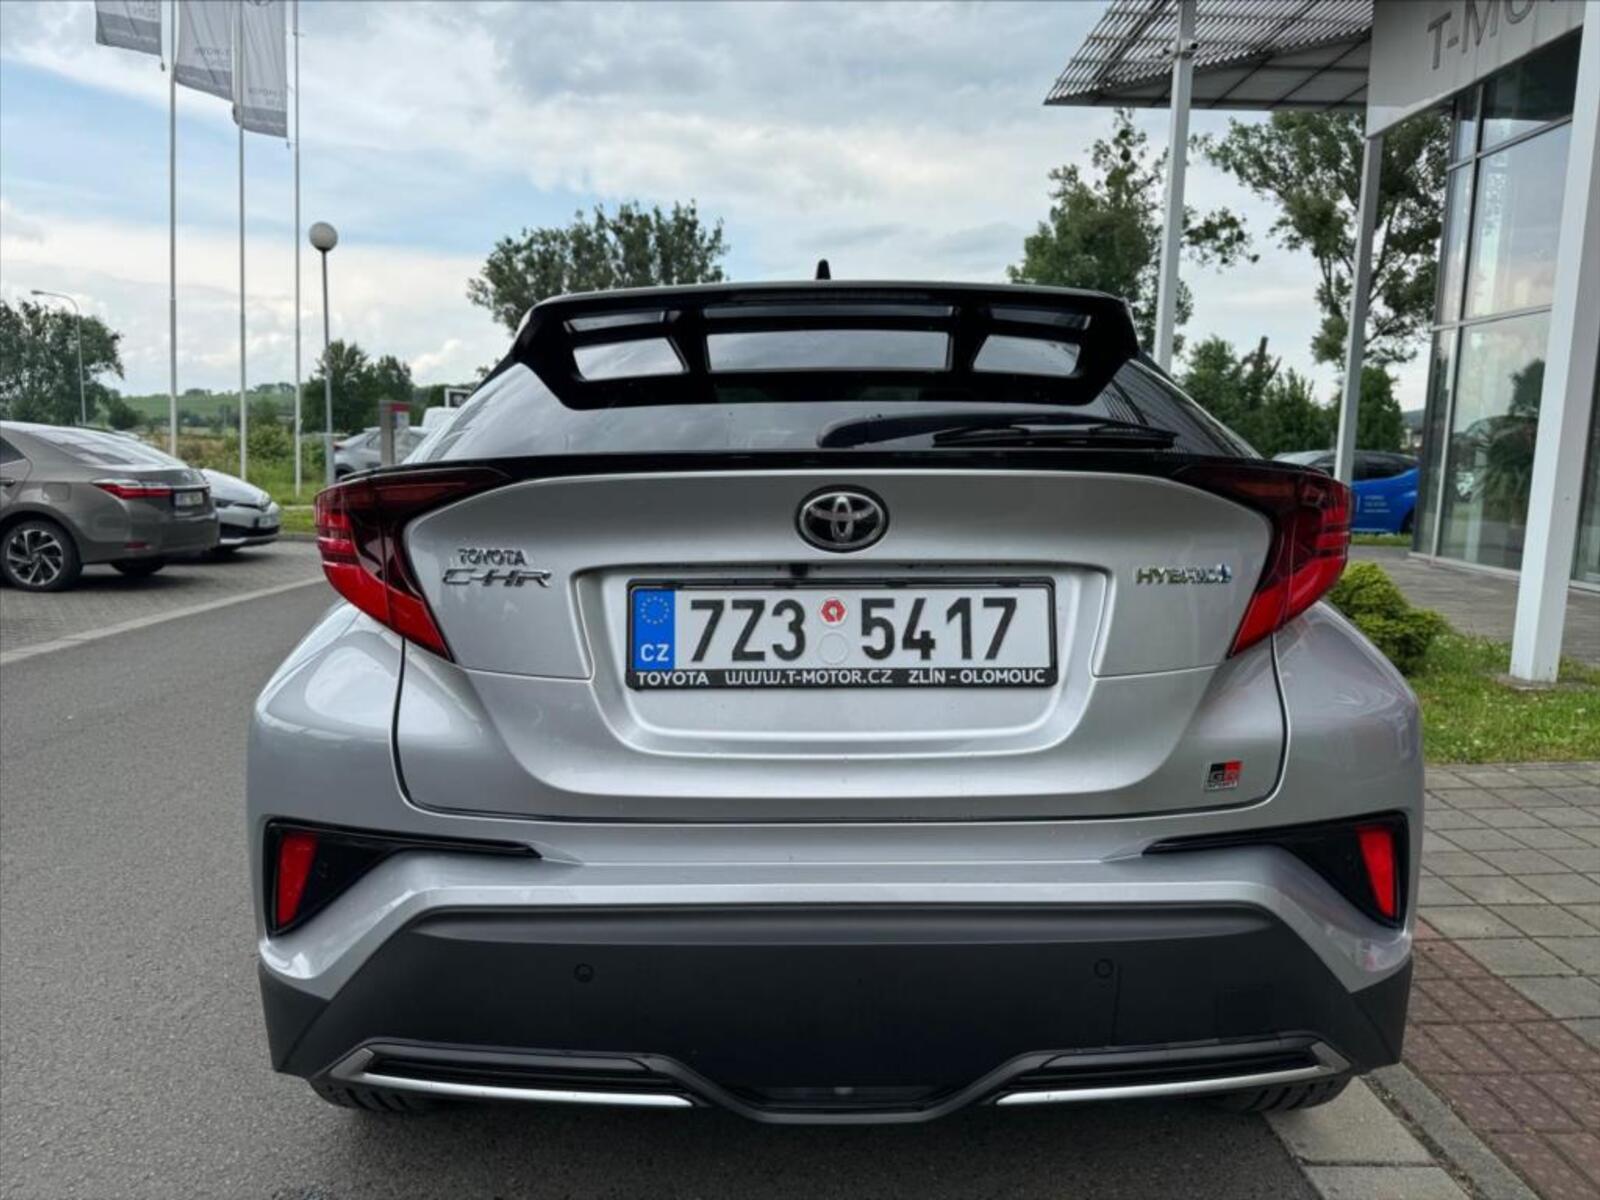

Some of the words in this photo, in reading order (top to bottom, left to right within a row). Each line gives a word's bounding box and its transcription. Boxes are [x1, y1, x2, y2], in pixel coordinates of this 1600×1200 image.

[1427, 0, 1554, 70] T-MO
[457, 548, 527, 566] TOYOTA
[442, 569, 552, 588] C-HR
[1136, 566, 1219, 584] HYBRID
[690, 598, 806, 662] 7Z3
[860, 597, 1018, 661] 5417
[640, 643, 670, 662] CZ
[636, 671, 709, 685] TOYOTA
[725, 670, 893, 685] WWW.T-MOTOR.CZ
[960, 669, 1046, 684] OLOMOUC
